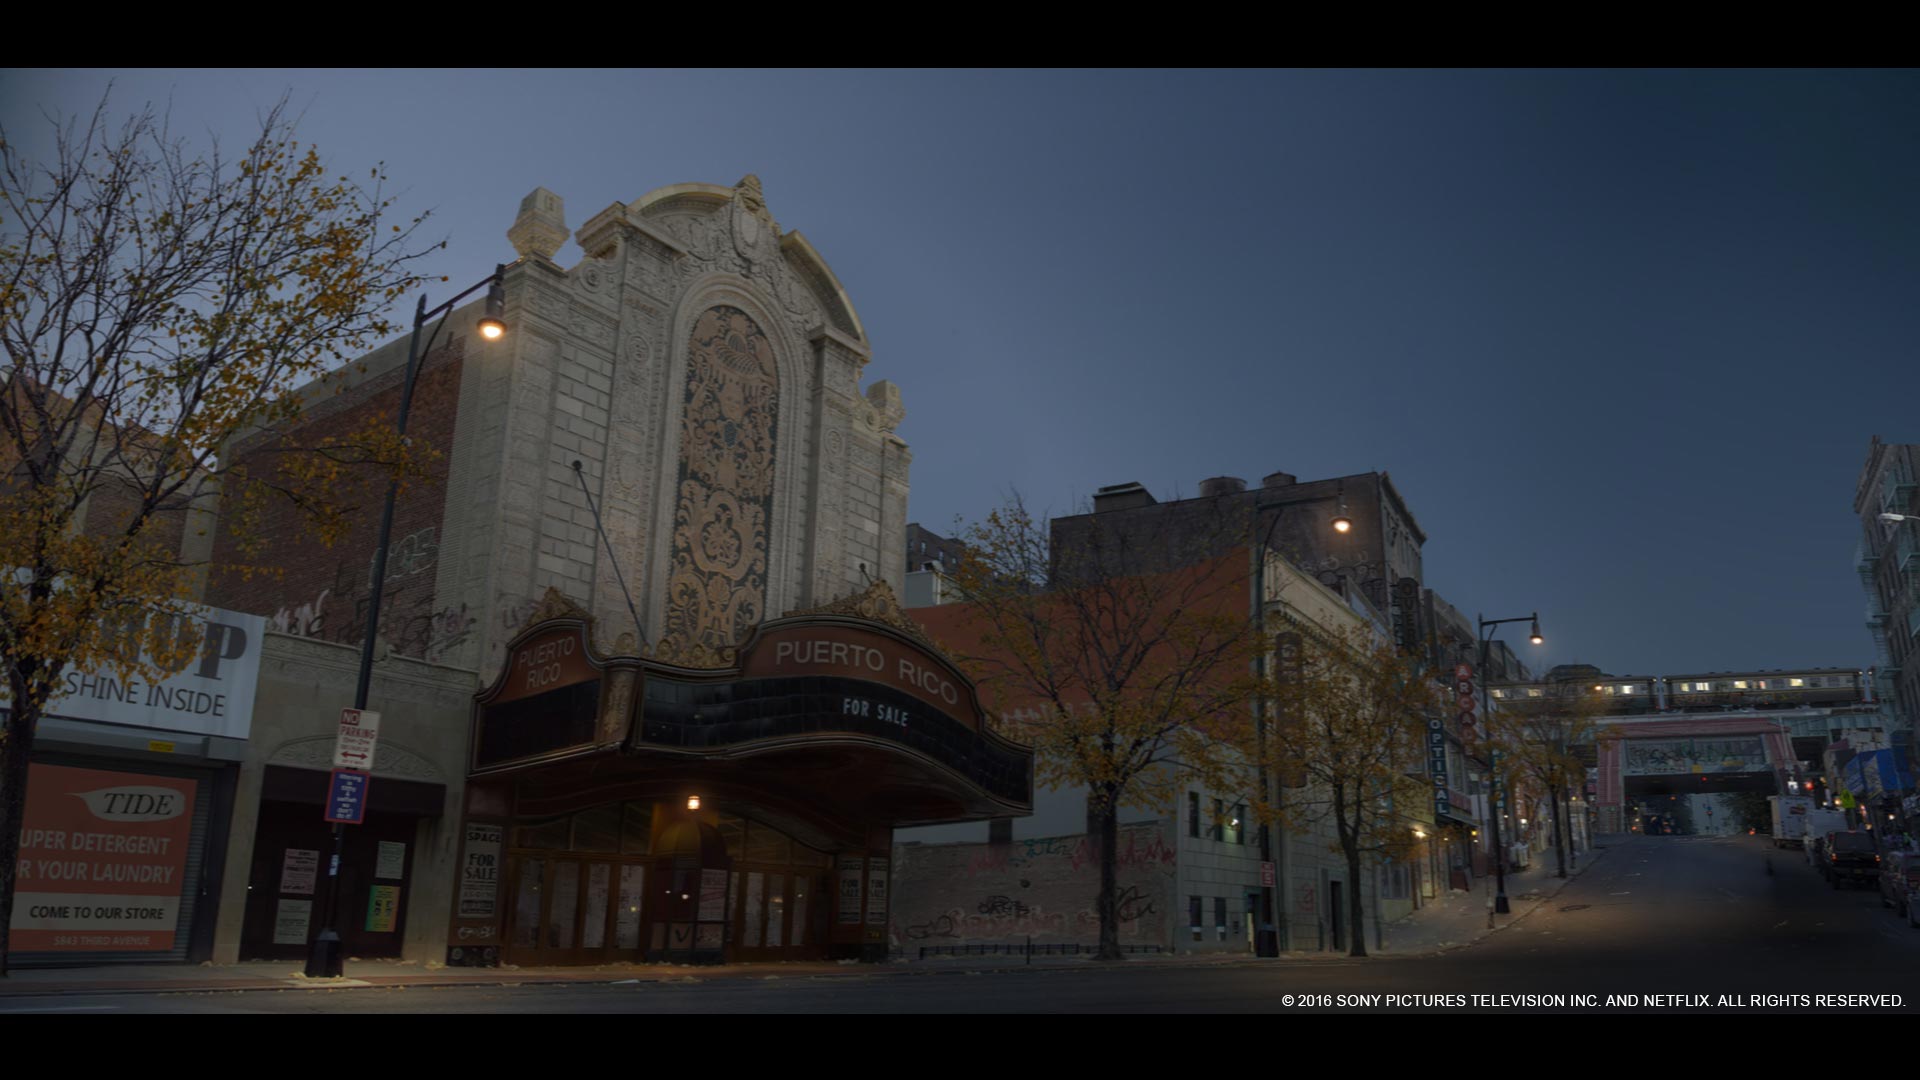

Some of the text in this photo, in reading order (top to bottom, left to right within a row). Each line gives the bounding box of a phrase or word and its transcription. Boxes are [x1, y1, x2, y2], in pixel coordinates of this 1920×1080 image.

[517, 636, 576, 670] PUERTO
[526, 662, 562, 690] RICO
[775, 640, 959, 706] PUERTO RICO
[66, 671, 226, 717] SHINE INSIDE
[342, 711, 359, 724] NO
[842, 697, 910, 728] FOR SALE
[340, 726, 376, 740] PARKING
[1429, 718, 1448, 815] OPTICAL
[104, 792, 174, 816] TIDE
[19, 828, 172, 856] UPER DETERGENT
[468, 852, 496, 867] FOR
[37, 860, 88, 881] YOUR
[92, 863, 176, 885] LAUNDRY
[464, 866, 498, 881] SALE
[30, 905, 164, 921] COME TO OUR STORE
[112, 936, 152, 947] AVENUE
